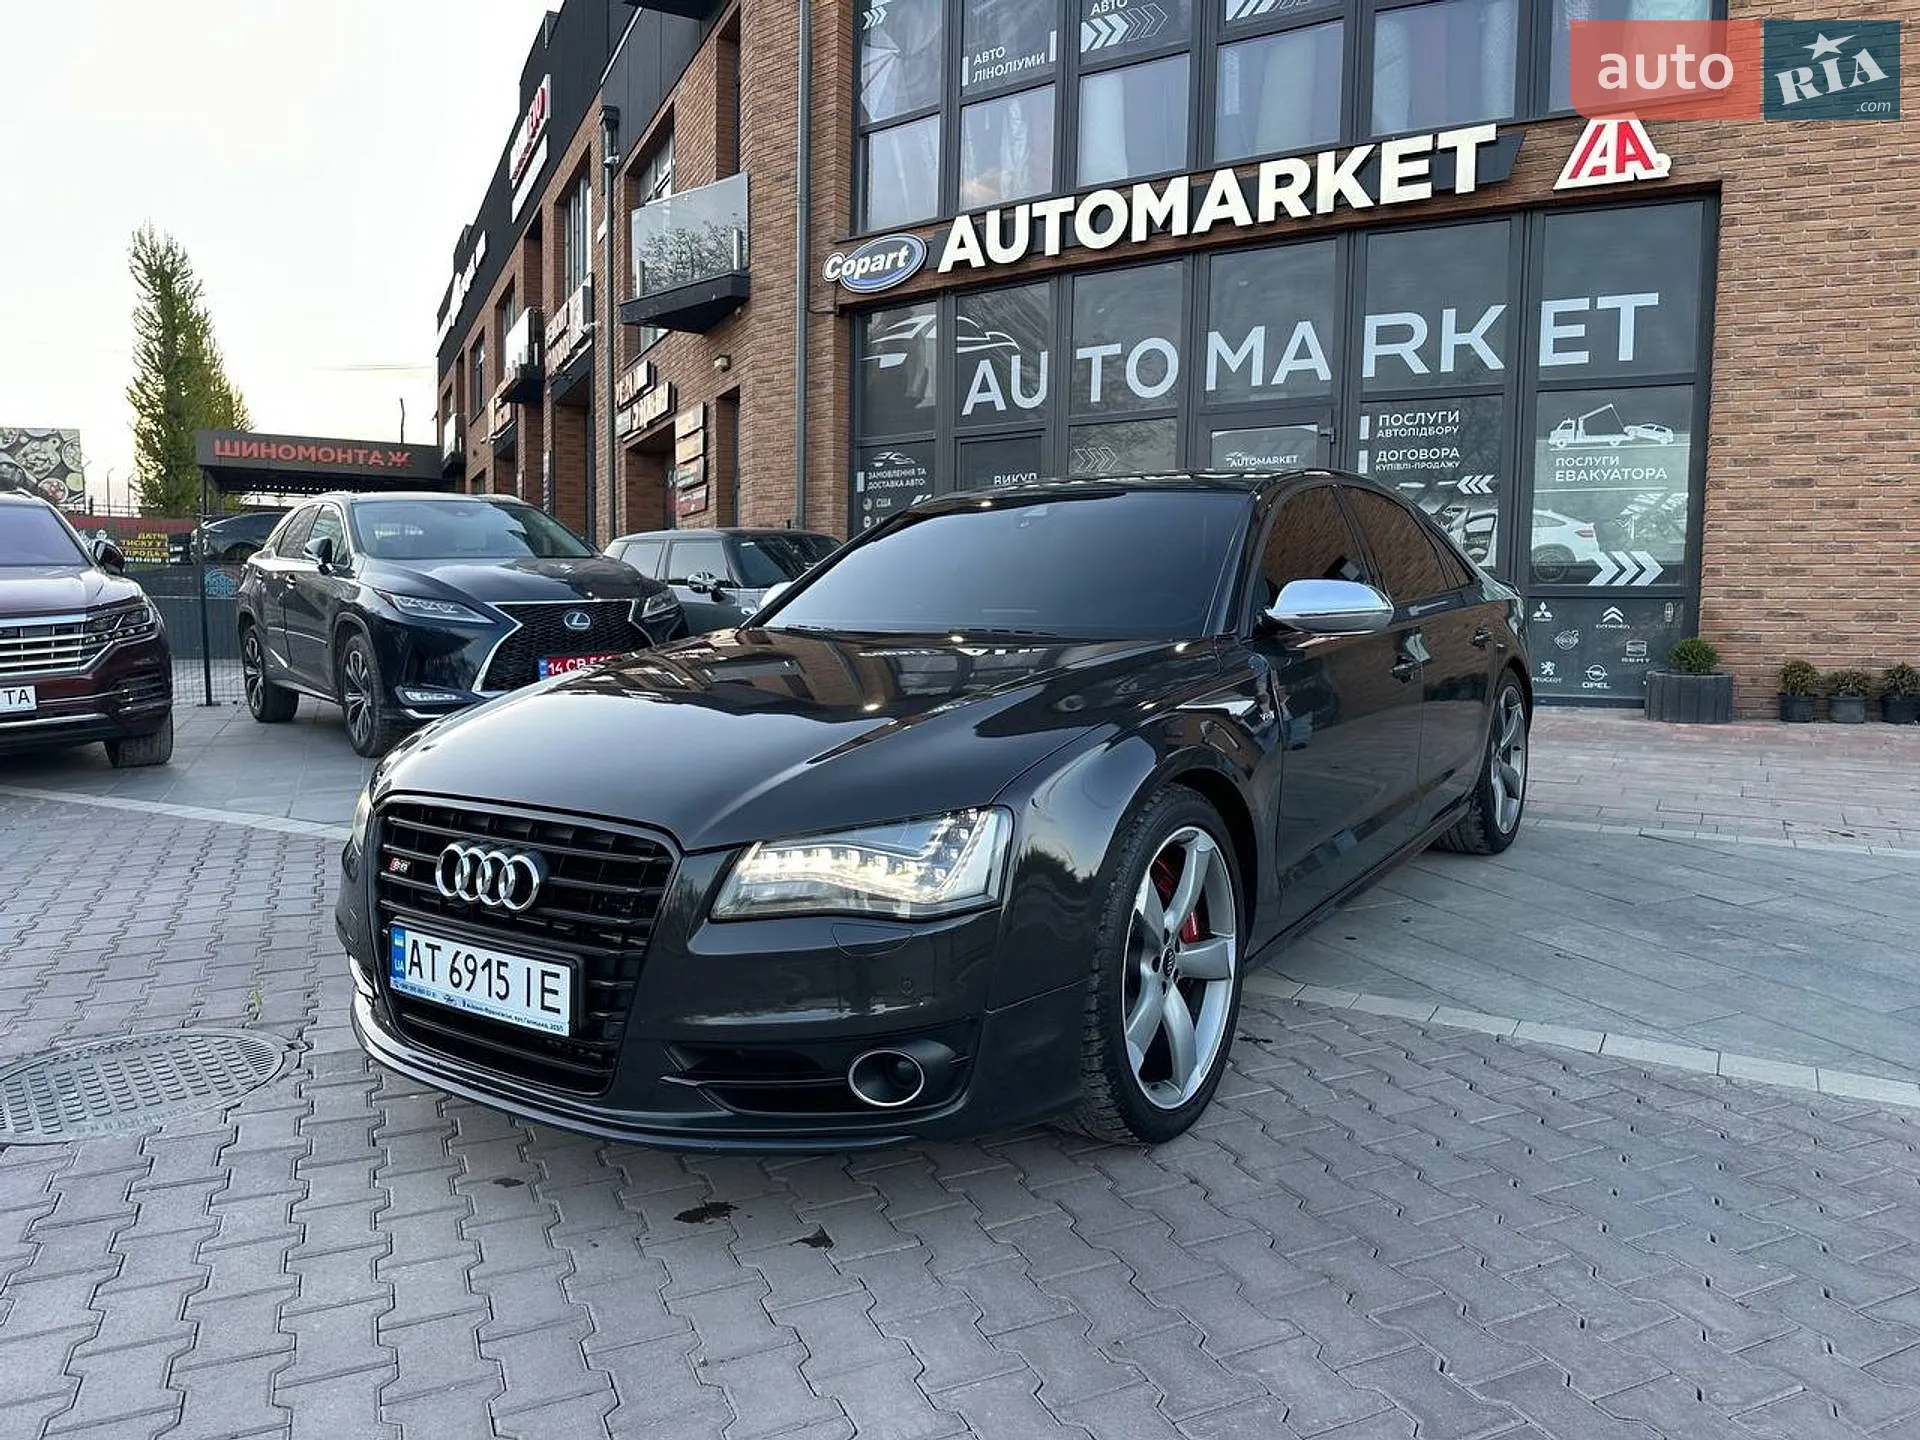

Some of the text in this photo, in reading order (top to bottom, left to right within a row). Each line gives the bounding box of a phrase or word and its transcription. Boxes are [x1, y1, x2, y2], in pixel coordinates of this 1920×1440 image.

[973, 46, 1005, 66] АВТО
[972, 52, 1046, 83] ЛІНОЛІУМИ
[938, 124, 1497, 273] AUTOMARKET
[825, 244, 909, 280] Copart
[1379, 410, 1459, 427] ПОСЛУГИ
[1376, 425, 1459, 438] АВТОПІДБОРУ
[213, 439, 411, 468] ШИНОМОНТАЖ
[1376, 447, 1460, 463] ДОГОВОРА
[1555, 455, 1620, 467] ПОСЛУГИ
[1230, 455, 1298, 468] AUTOMARKET
[1375, 460, 1460, 472] КУПІВЛІ-ПРОДАЖУ
[917, 468, 927, 476] ТА
[1555, 467, 1668, 482] ЕВАКУАТОРА
[867, 480, 904, 491] ДОСТАВКА
[548, 661, 563, 675] 14
[1582, 681, 1610, 689] OPEL
[3, 689, 30, 705] TA
[408, 939, 442, 982] AT
[449, 950, 510, 1001] 6915
[526, 967, 561, 1015] IE
